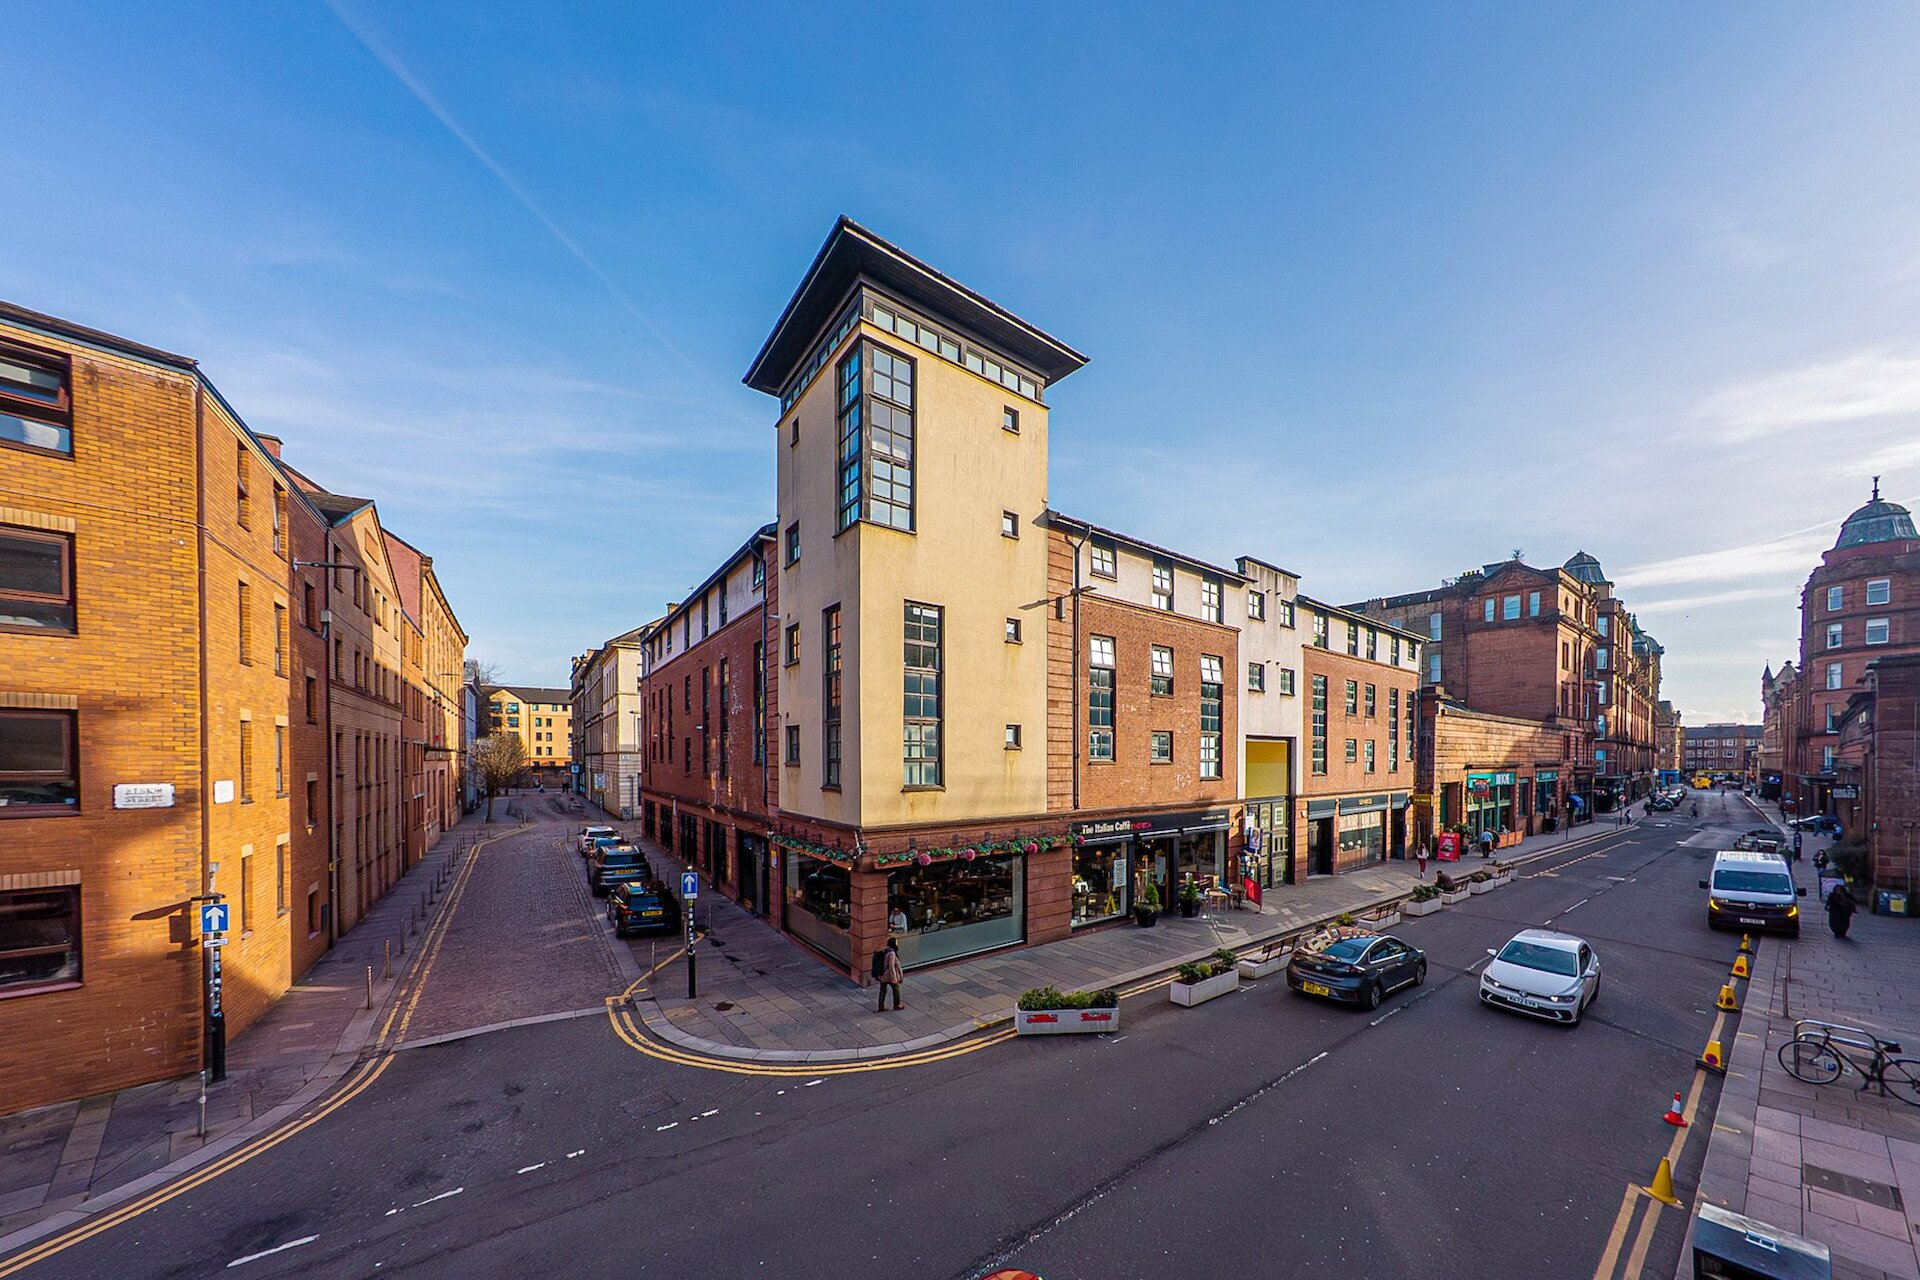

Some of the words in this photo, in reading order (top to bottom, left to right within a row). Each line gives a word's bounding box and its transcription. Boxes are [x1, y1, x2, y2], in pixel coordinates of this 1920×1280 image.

[124, 795, 164, 803] STREET
[1082, 824, 1094, 835] The
[1094, 822, 1114, 834] Italian
